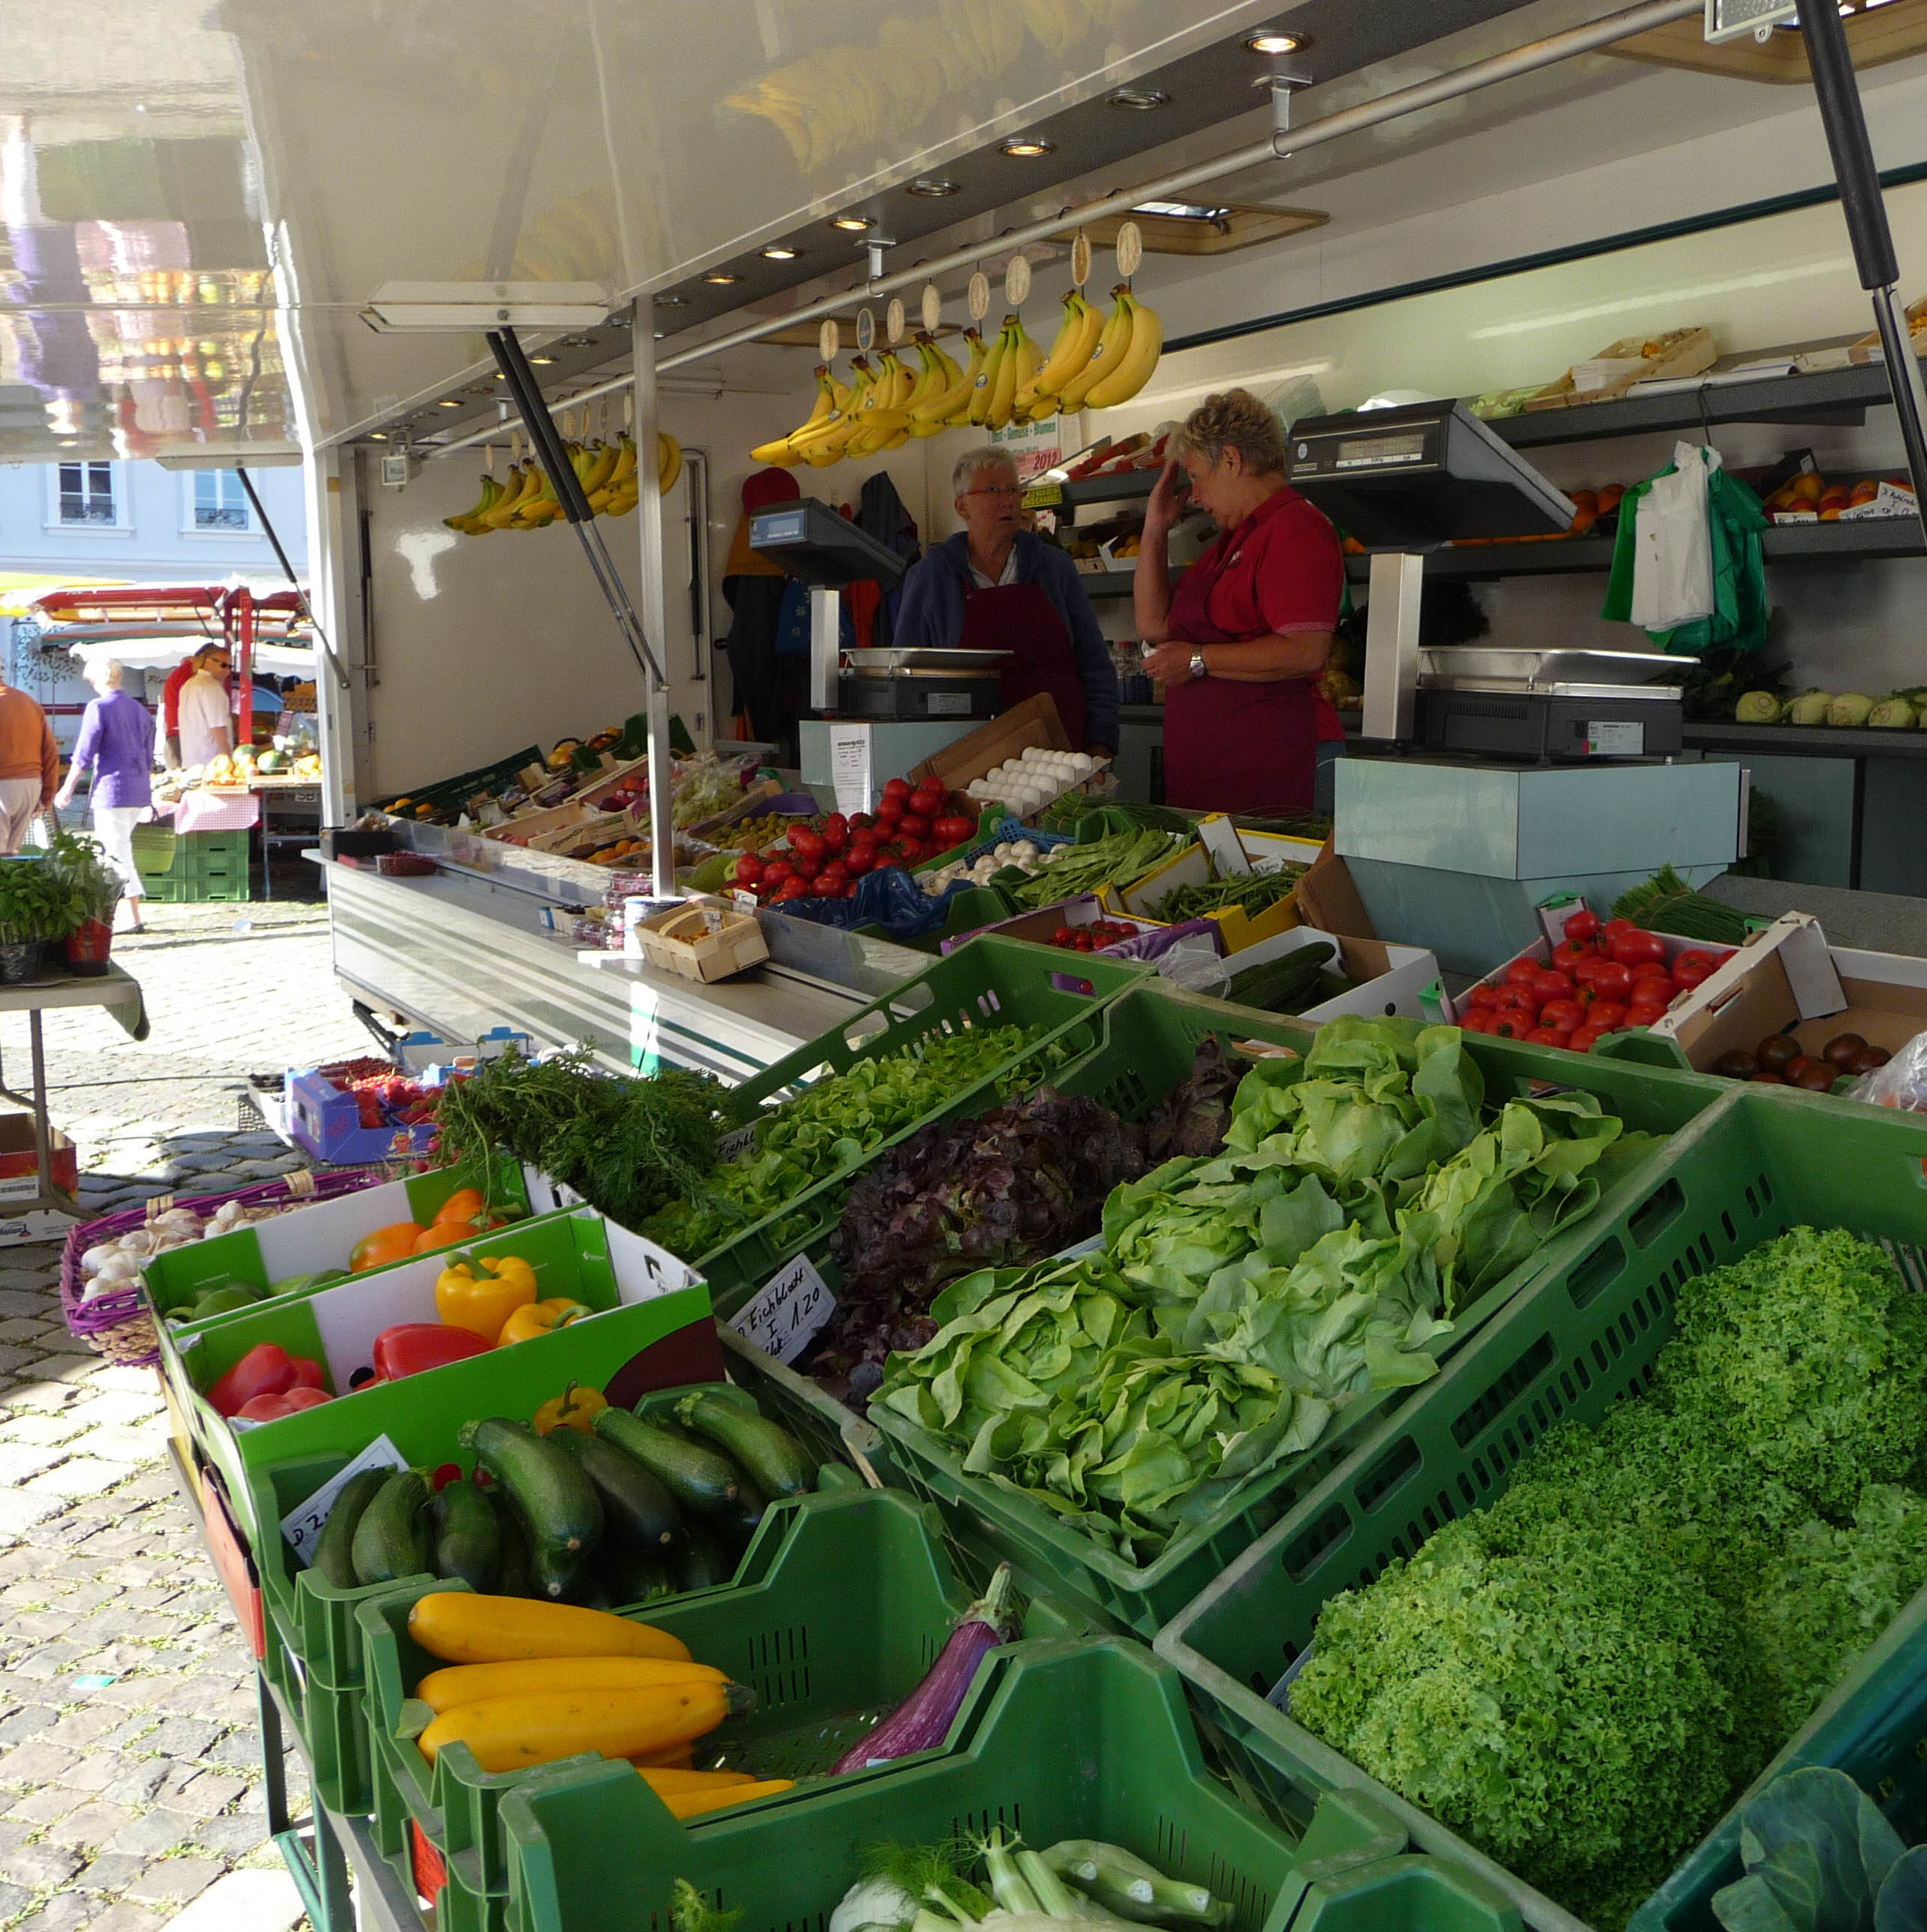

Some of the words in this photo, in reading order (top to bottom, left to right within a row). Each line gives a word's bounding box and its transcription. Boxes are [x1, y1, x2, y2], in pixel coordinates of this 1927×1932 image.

[1033, 452, 1058, 470] 2012
[749, 1267, 804, 1330] Eichblatt
[791, 1287, 819, 1330] 1.20
